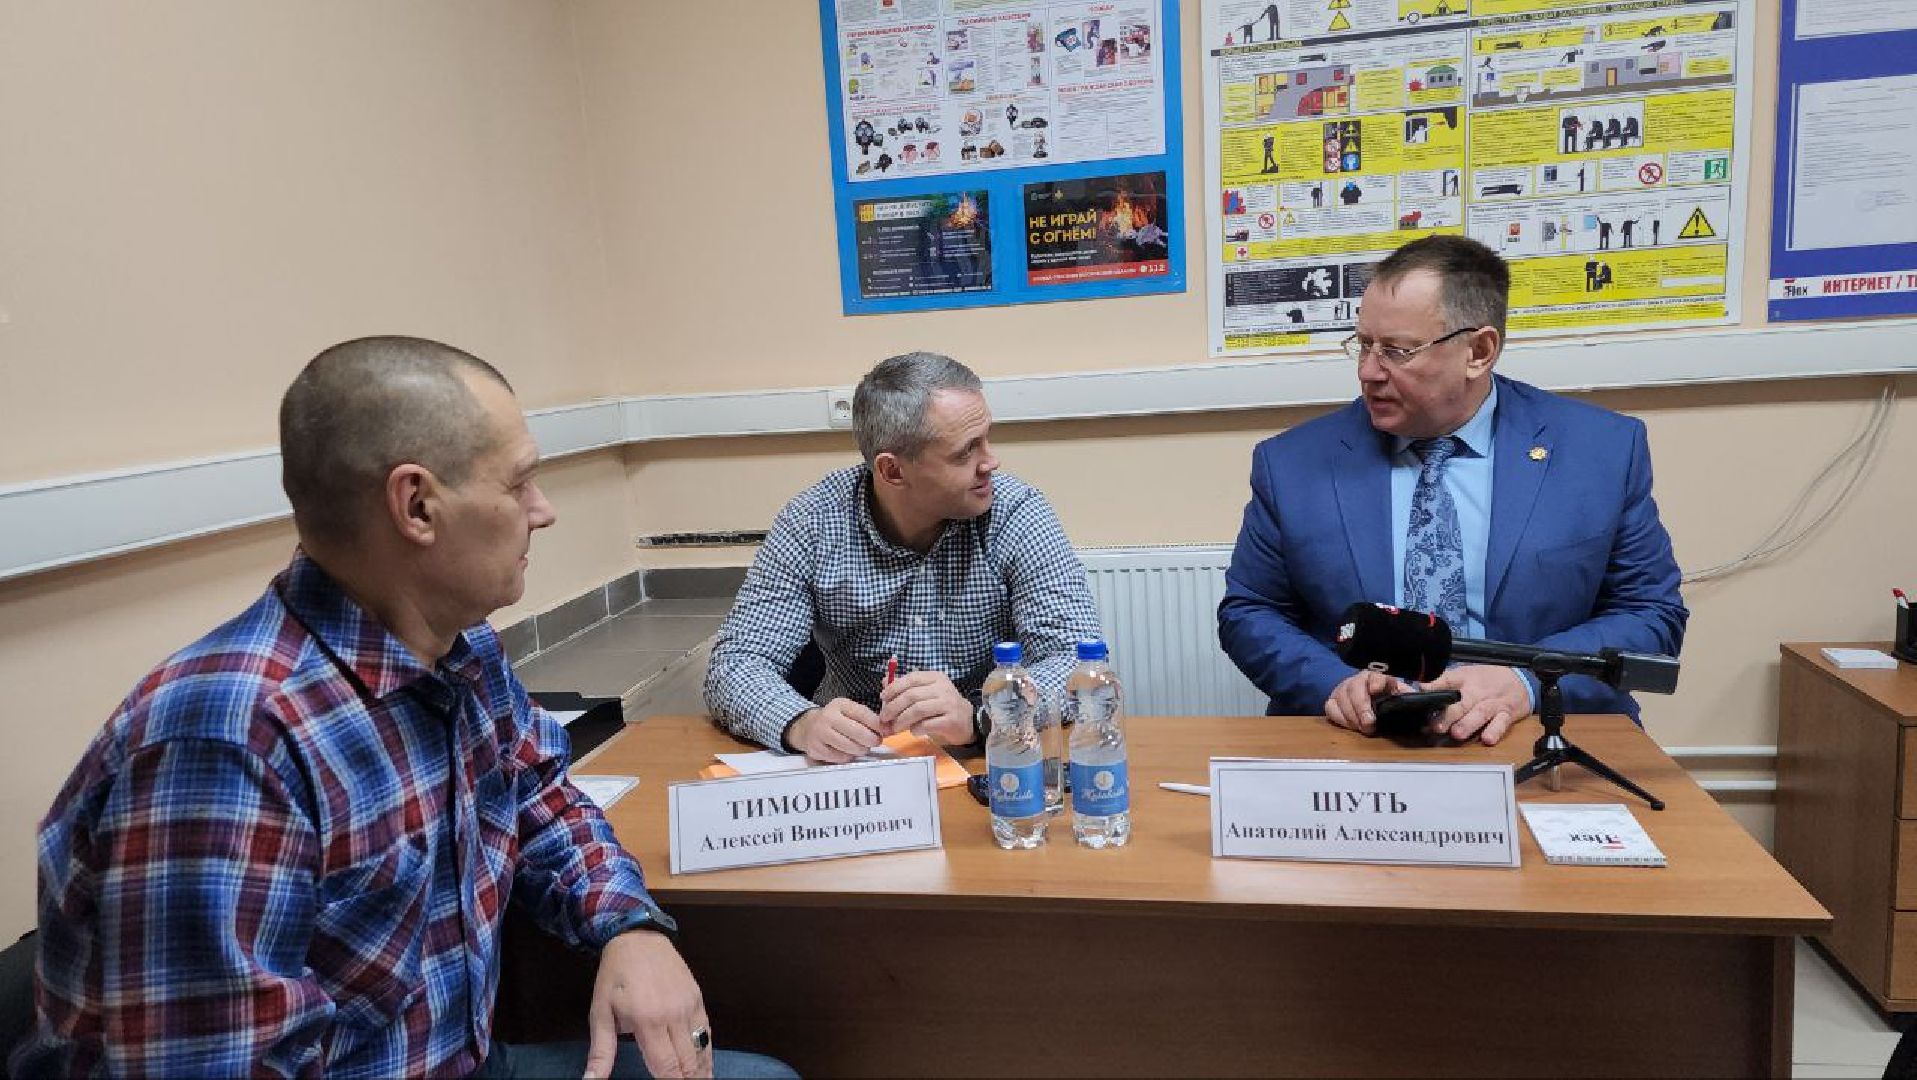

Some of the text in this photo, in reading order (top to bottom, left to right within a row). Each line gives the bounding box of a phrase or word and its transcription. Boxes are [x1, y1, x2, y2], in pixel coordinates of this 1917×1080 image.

[1029, 208, 1097, 229] НЕ ИГРАЙ
[1029, 226, 1097, 244] С ОГНЁМ!
[1823, 276, 1892, 293] ИНТЕРНЕТ
[726, 785, 883, 820] ТИМОШИН
[1312, 791, 1408, 814] ШУТЬ
[700, 816, 913, 852] Алексей Викторович
[1225, 822, 1504, 847] Анатолий Александрович
